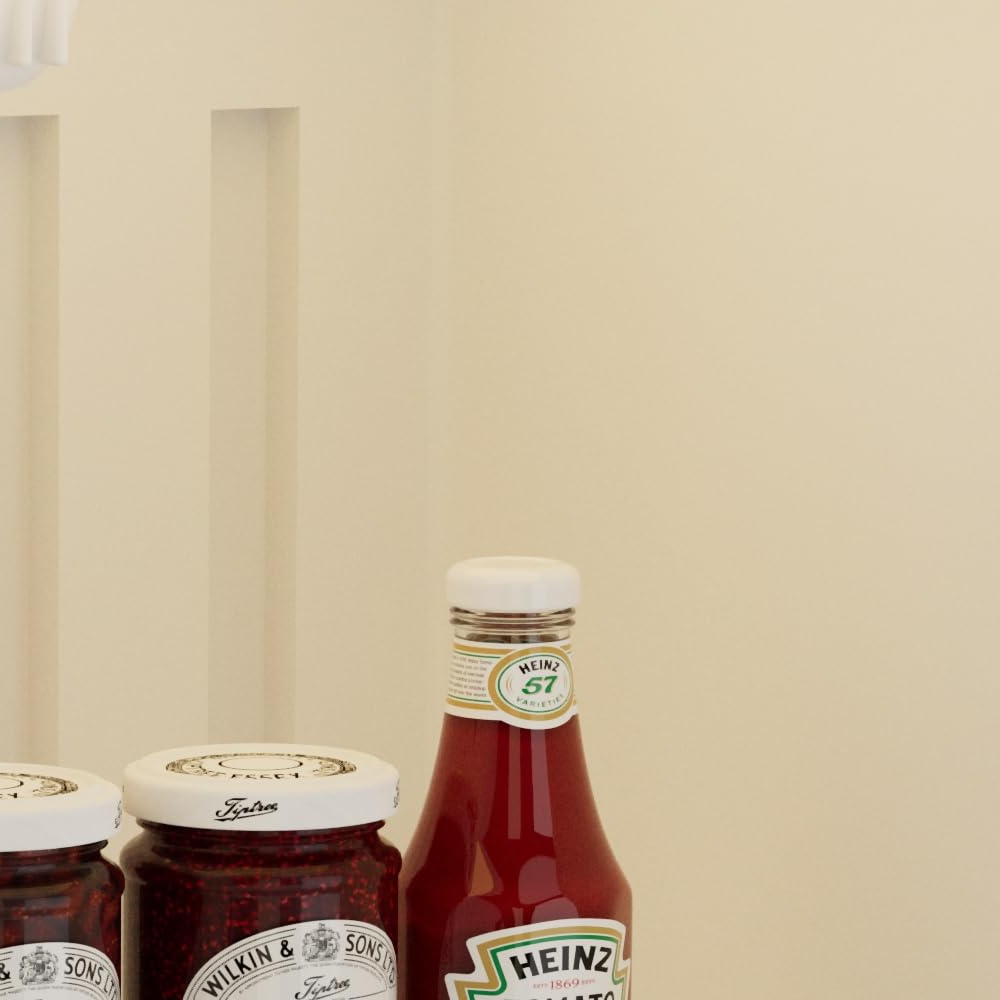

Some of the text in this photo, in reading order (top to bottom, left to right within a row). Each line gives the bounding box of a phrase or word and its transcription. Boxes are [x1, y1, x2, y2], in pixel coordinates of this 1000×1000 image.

[518, 659, 560, 675] HEINZ
[521, 675, 558, 695] 57
[213, 797, 278, 822] Tiptree
[64, 956, 103, 989] SONS
[202, 945, 272, 998] WILKIN
[280, 939, 294, 958] &
[345, 933, 383, 963] SONS
[509, 945, 612, 980] HEINZ
[551, 978, 579, 990] 1869
